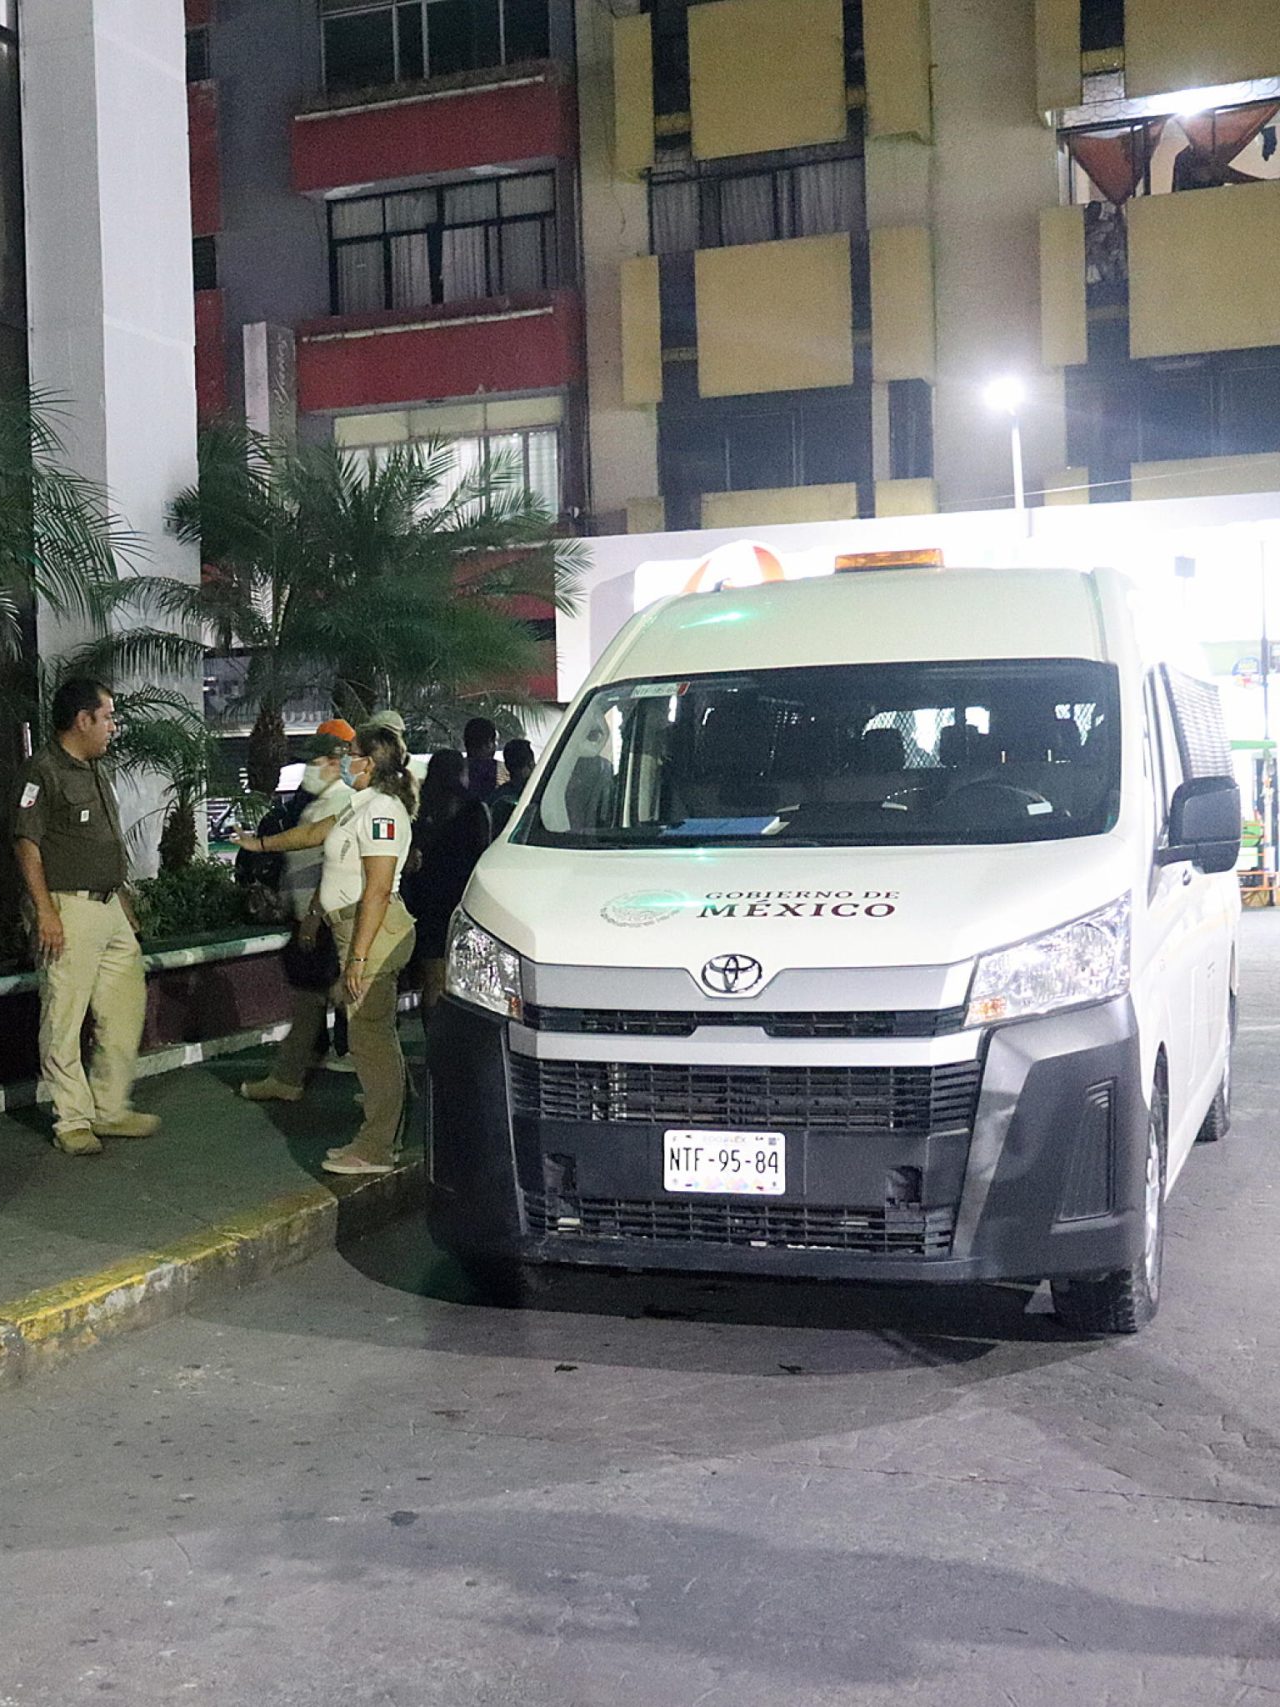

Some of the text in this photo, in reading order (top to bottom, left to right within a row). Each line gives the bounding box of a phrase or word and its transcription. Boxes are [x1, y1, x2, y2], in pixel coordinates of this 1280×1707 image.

[705, 890, 900, 899] GOBIERNO DE
[696, 899, 895, 918] MÉXICO
[669, 1147, 778, 1174] NTF-95-84
